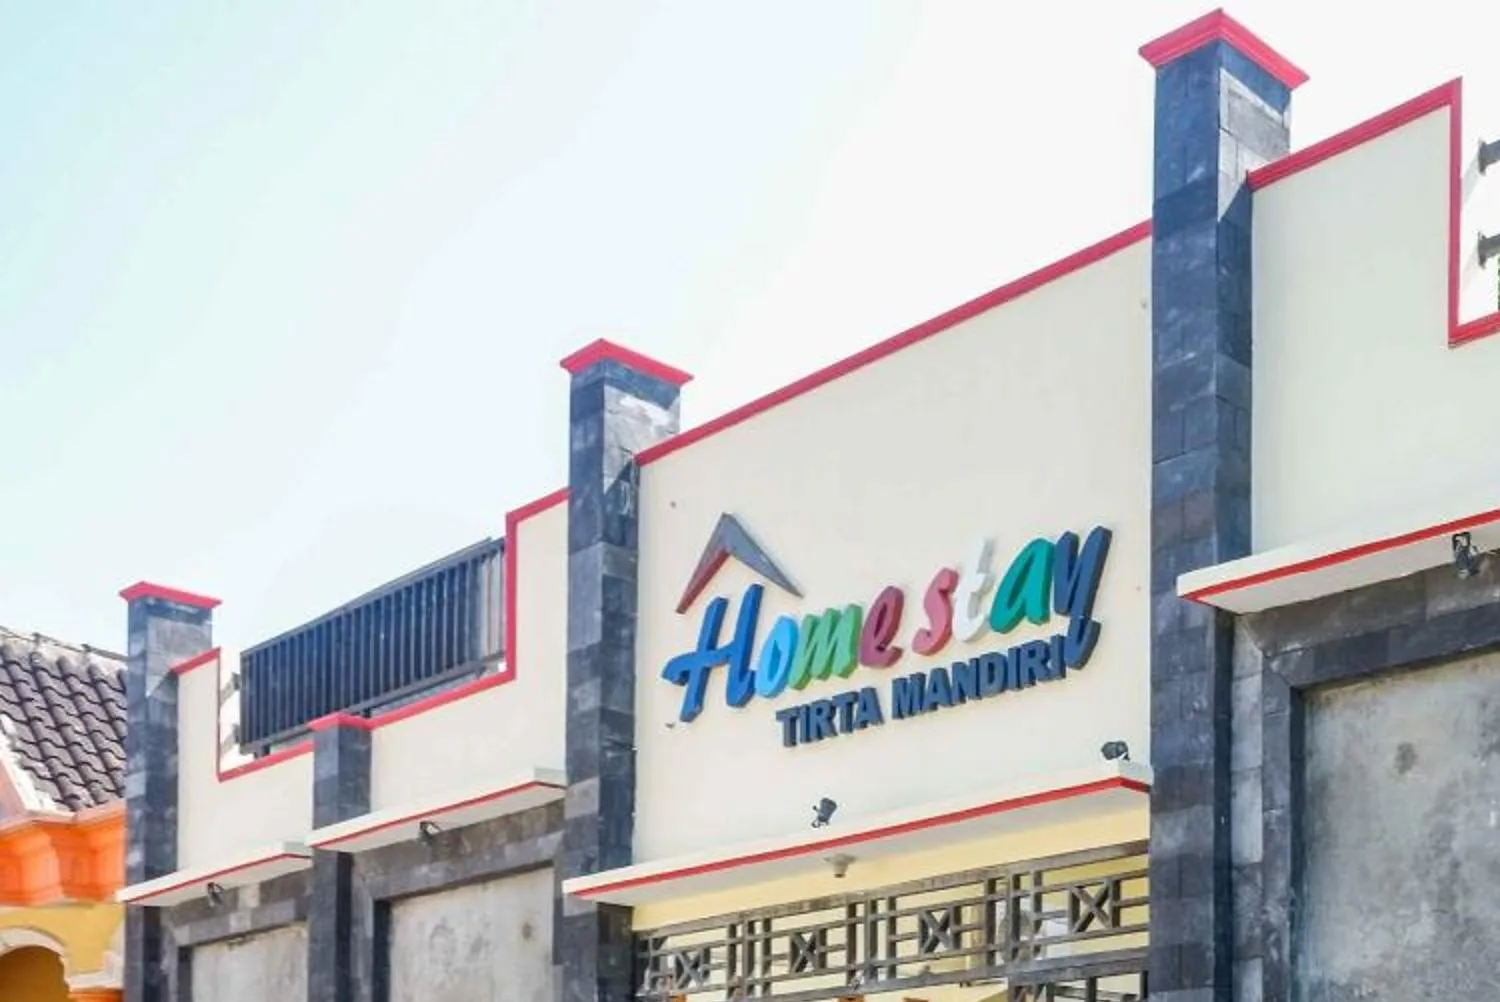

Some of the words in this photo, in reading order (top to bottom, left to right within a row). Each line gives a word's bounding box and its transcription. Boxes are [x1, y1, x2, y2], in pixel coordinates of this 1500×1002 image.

[662, 525, 1112, 722] Homestay
[776, 687, 884, 747] TIRTA
[892, 635, 1066, 719] MANDIRI
